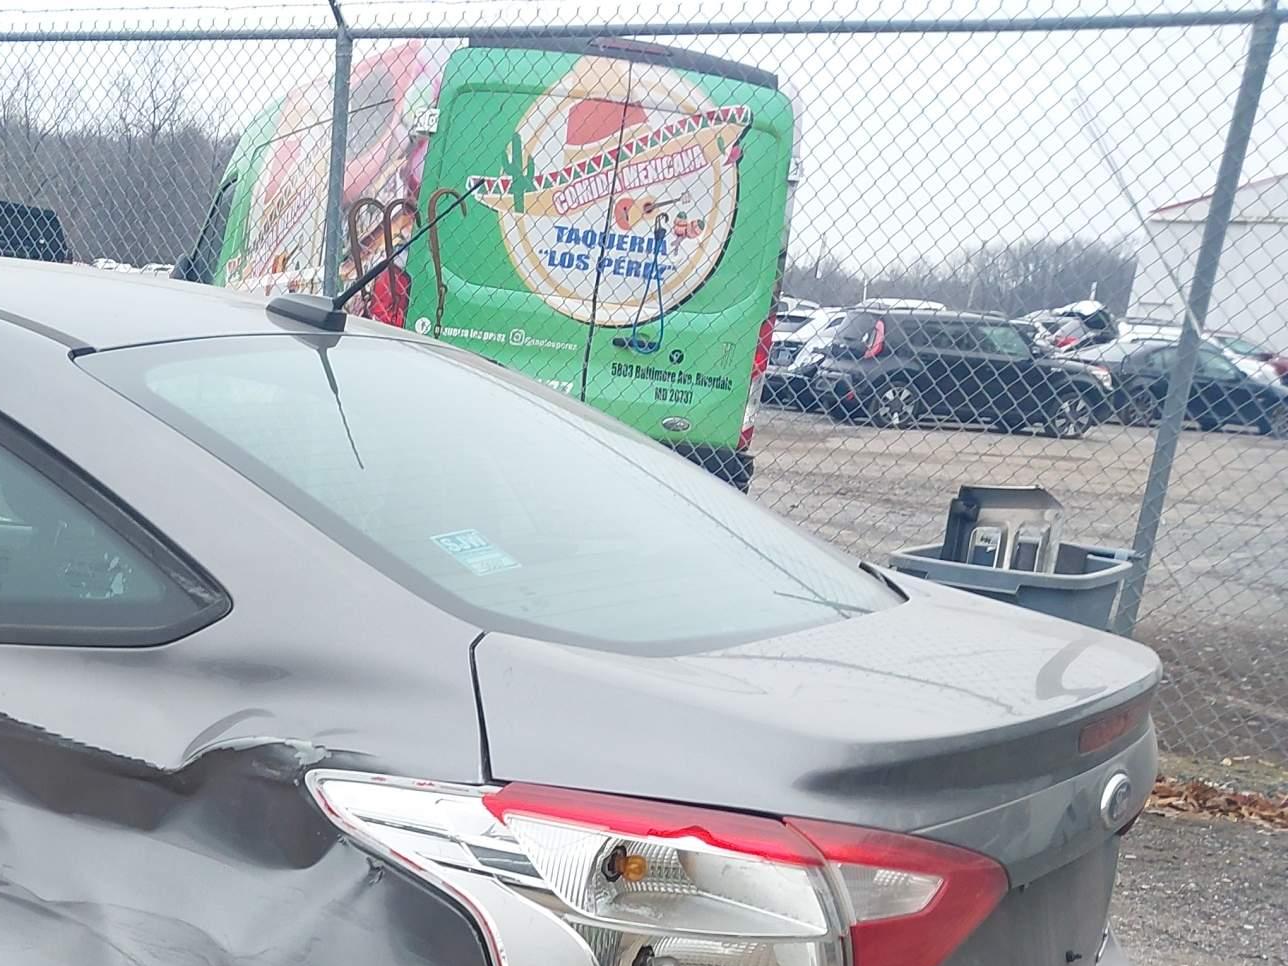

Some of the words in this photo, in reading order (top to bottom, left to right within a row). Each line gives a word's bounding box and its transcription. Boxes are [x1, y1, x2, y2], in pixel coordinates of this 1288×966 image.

[552, 170, 623, 215] COMIDA
[622, 145, 709, 190] MEXICANA
[635, 365, 676, 383] Baltimore
[655, 387, 668, 401] MD
